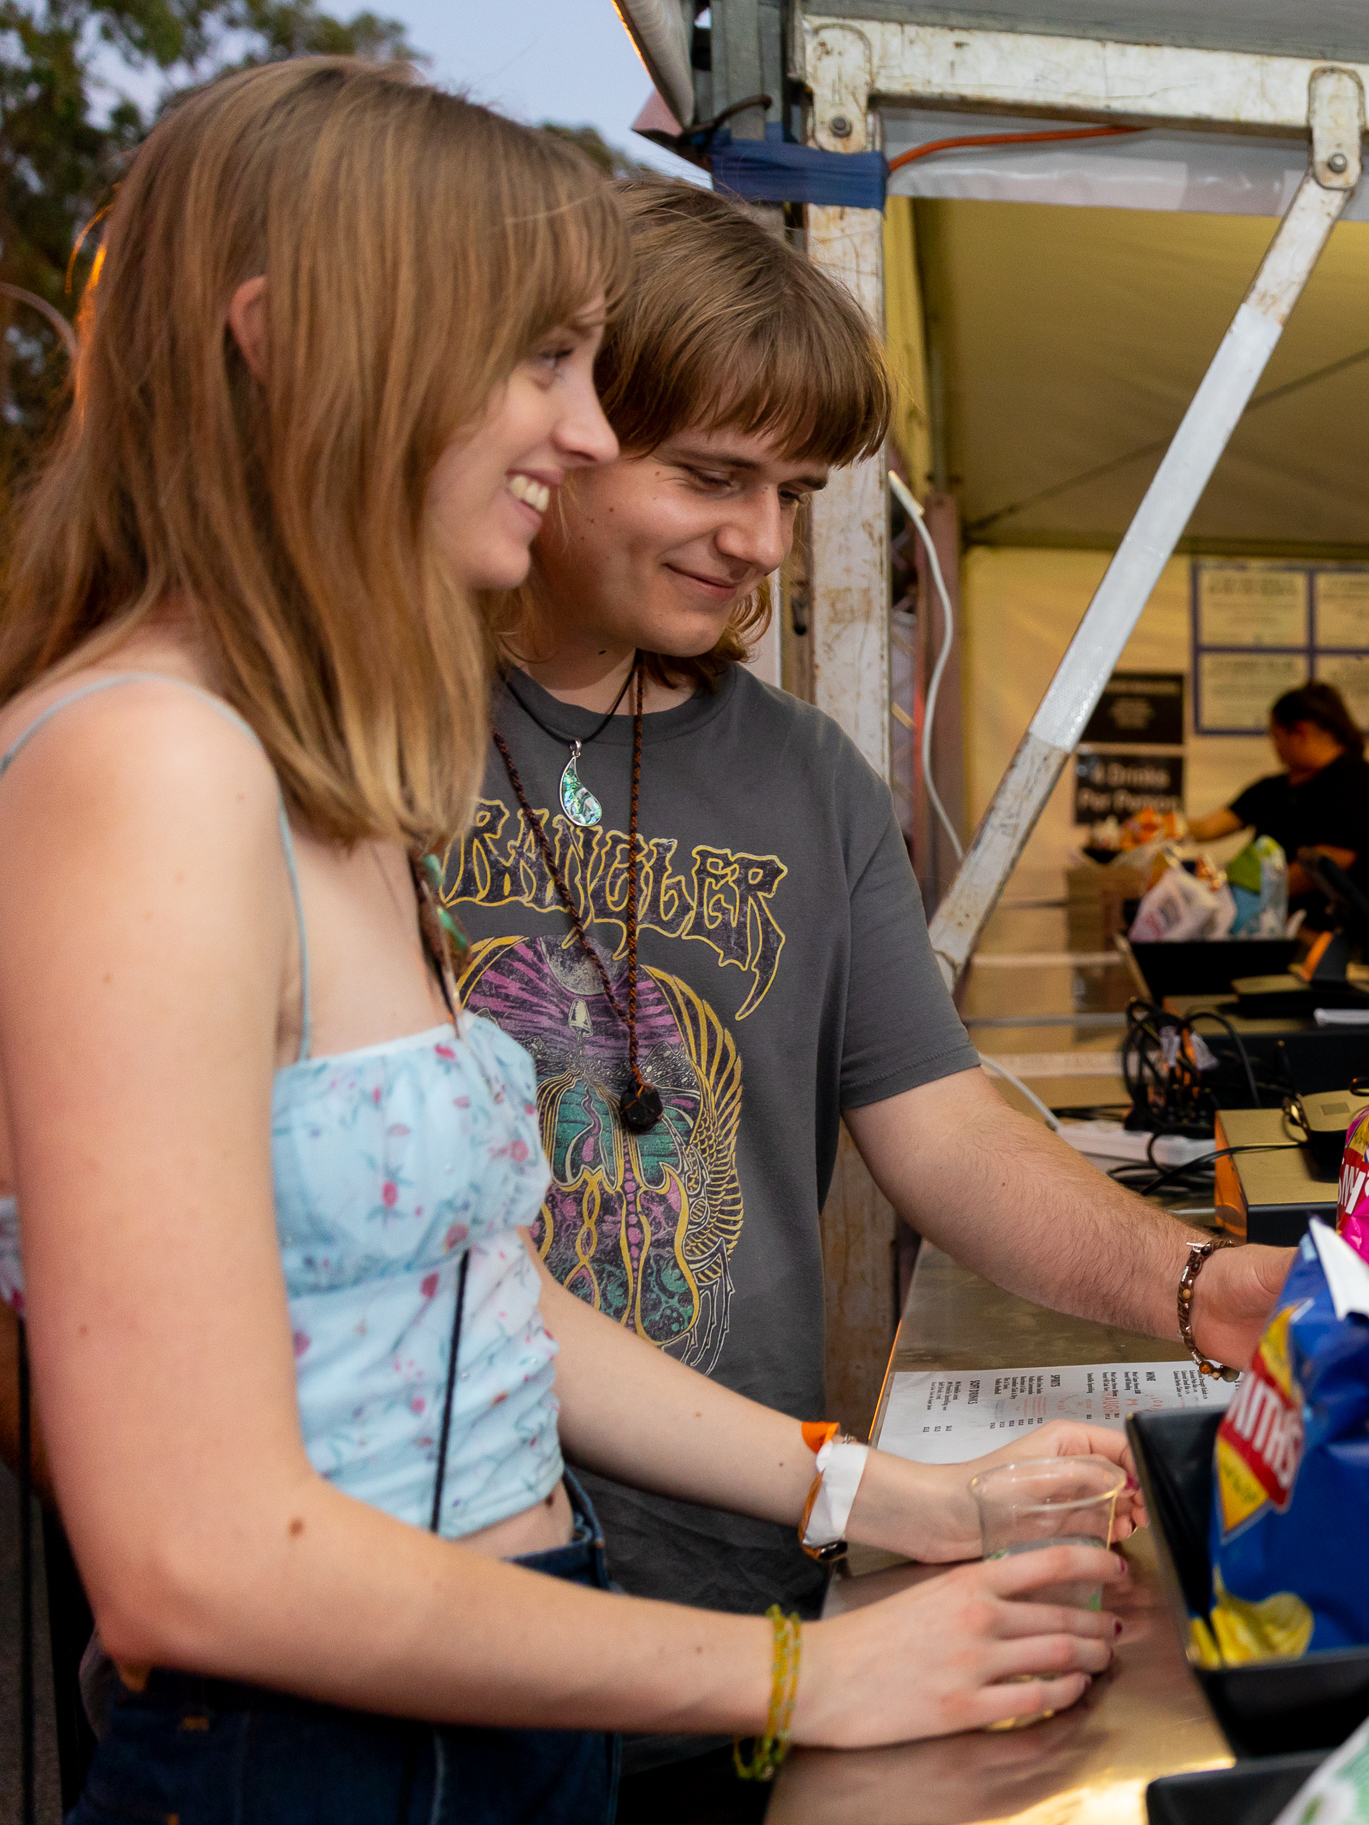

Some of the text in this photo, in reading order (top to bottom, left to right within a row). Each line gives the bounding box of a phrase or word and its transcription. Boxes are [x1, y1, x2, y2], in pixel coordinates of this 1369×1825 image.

[440, 798, 787, 1020] RANGLER
[1051, 1375, 1060, 1387] SPIRITS
[1146, 1371, 1156, 1381] WINE
